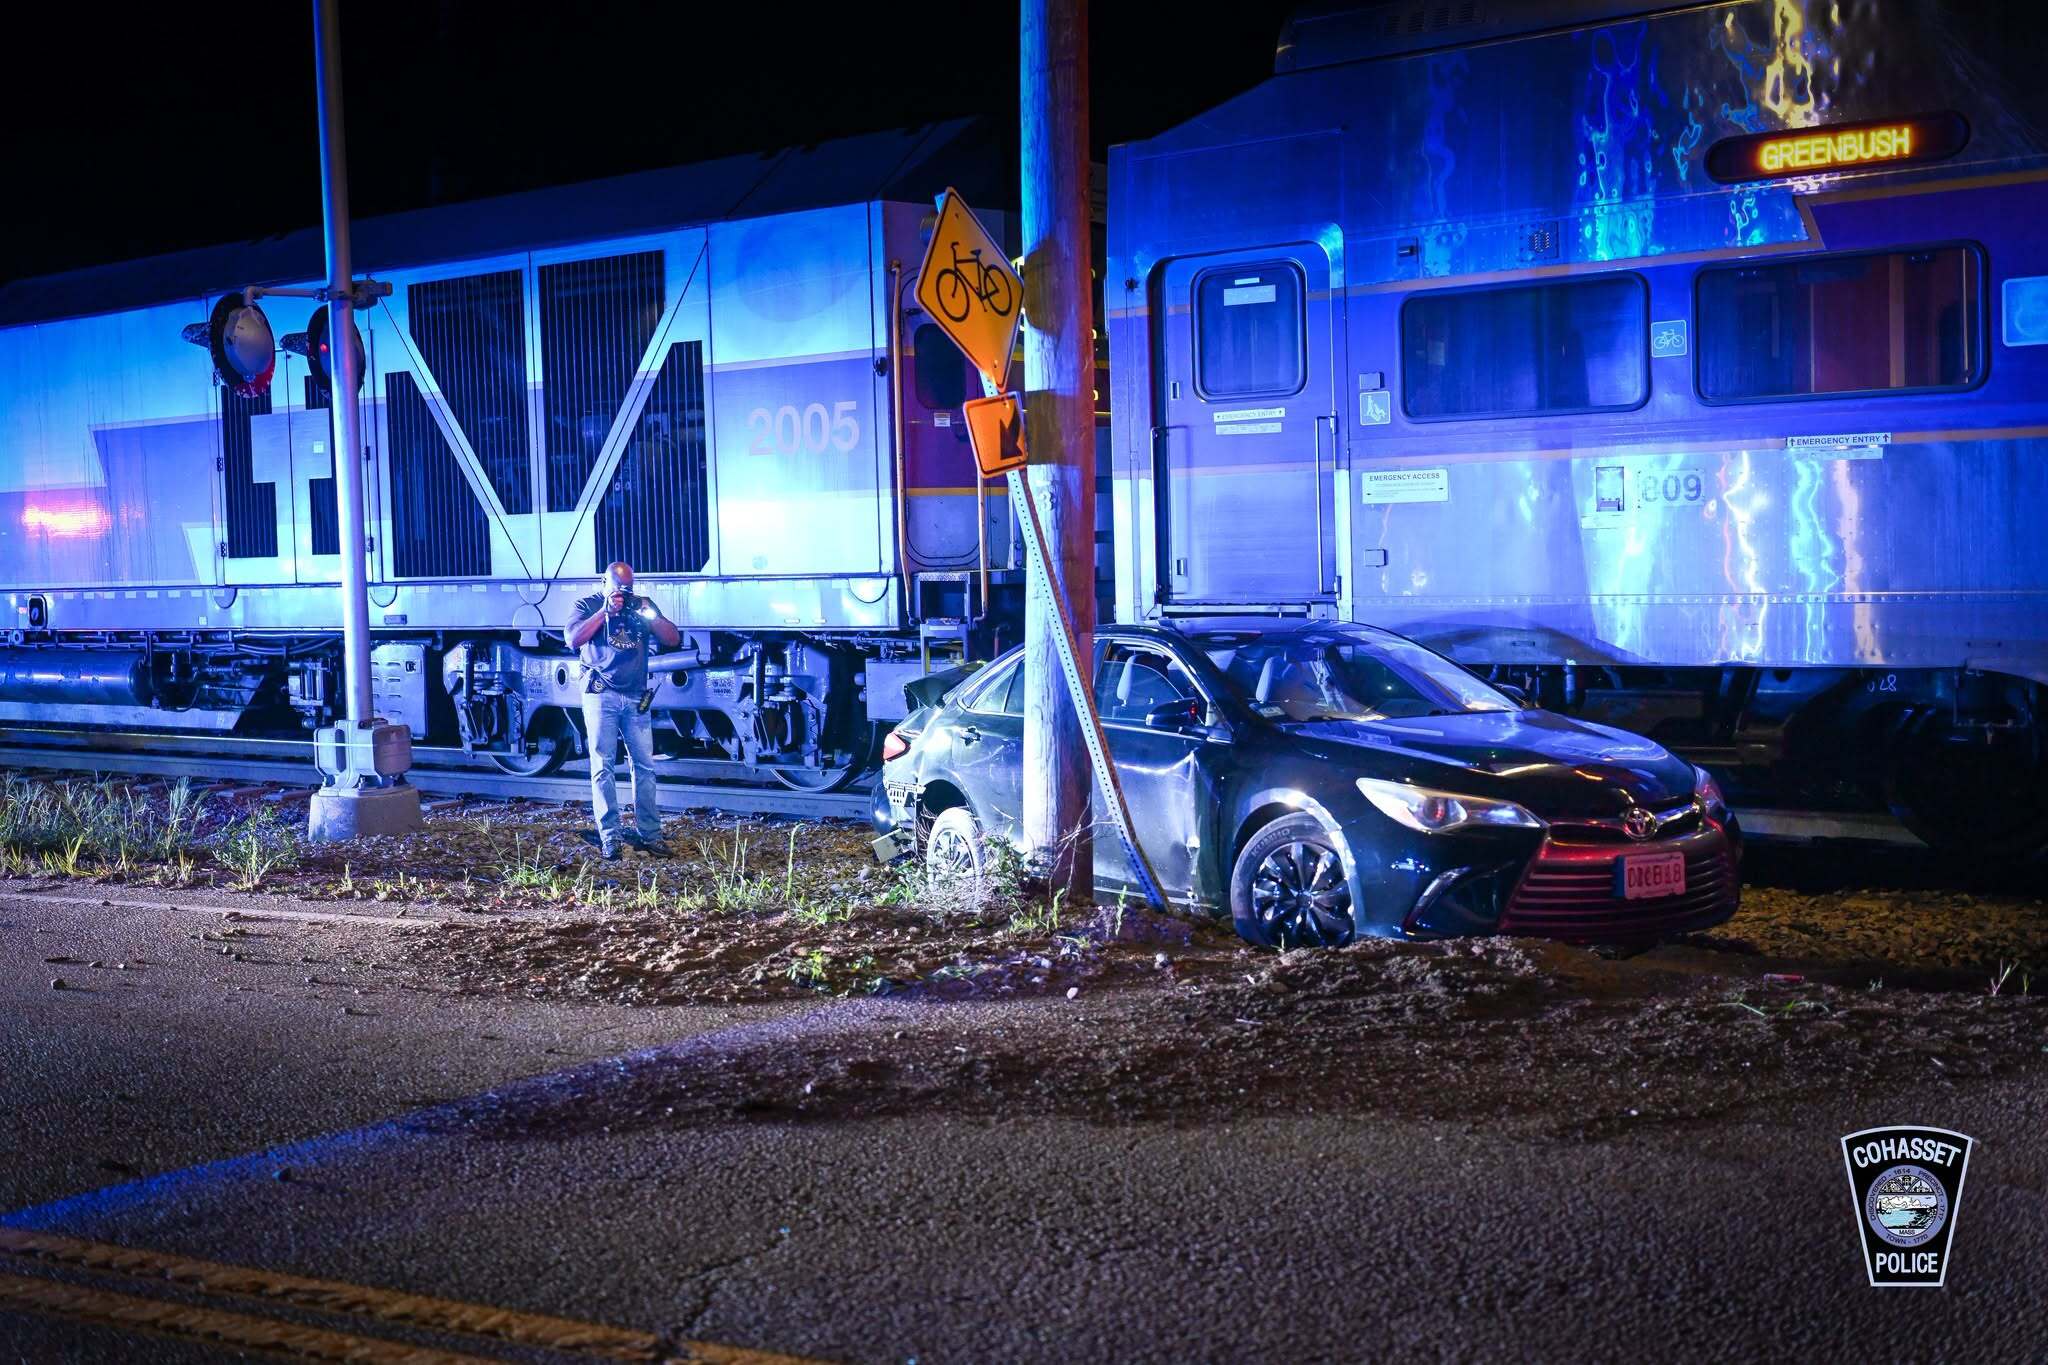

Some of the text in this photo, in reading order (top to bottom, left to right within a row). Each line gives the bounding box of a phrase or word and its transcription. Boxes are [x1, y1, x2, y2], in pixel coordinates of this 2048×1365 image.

[1762, 127, 1911, 171] GREENBUSH
[749, 401, 860, 456] 2005
[1796, 435, 1880, 446] EMERGENCY ENTRY
[1412, 472, 1440, 480] ACCESS
[1641, 474, 1702, 502] 809
